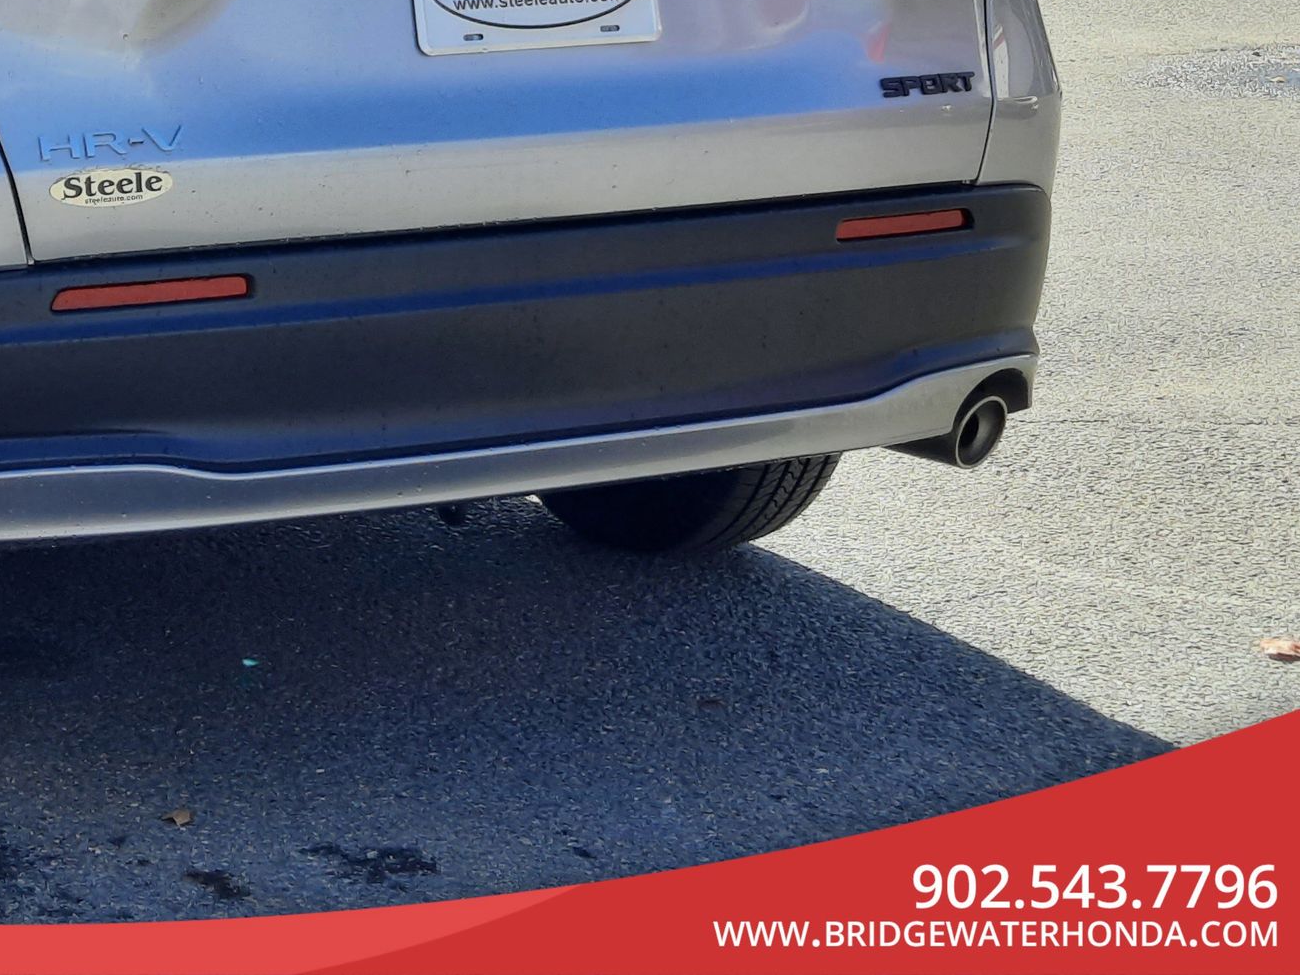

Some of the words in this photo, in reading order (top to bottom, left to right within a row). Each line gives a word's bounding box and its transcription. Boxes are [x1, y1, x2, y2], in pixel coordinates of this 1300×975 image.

[880, 71, 975, 98] SPORT
[37, 124, 182, 162] HR-V
[61, 171, 163, 200] Steele
